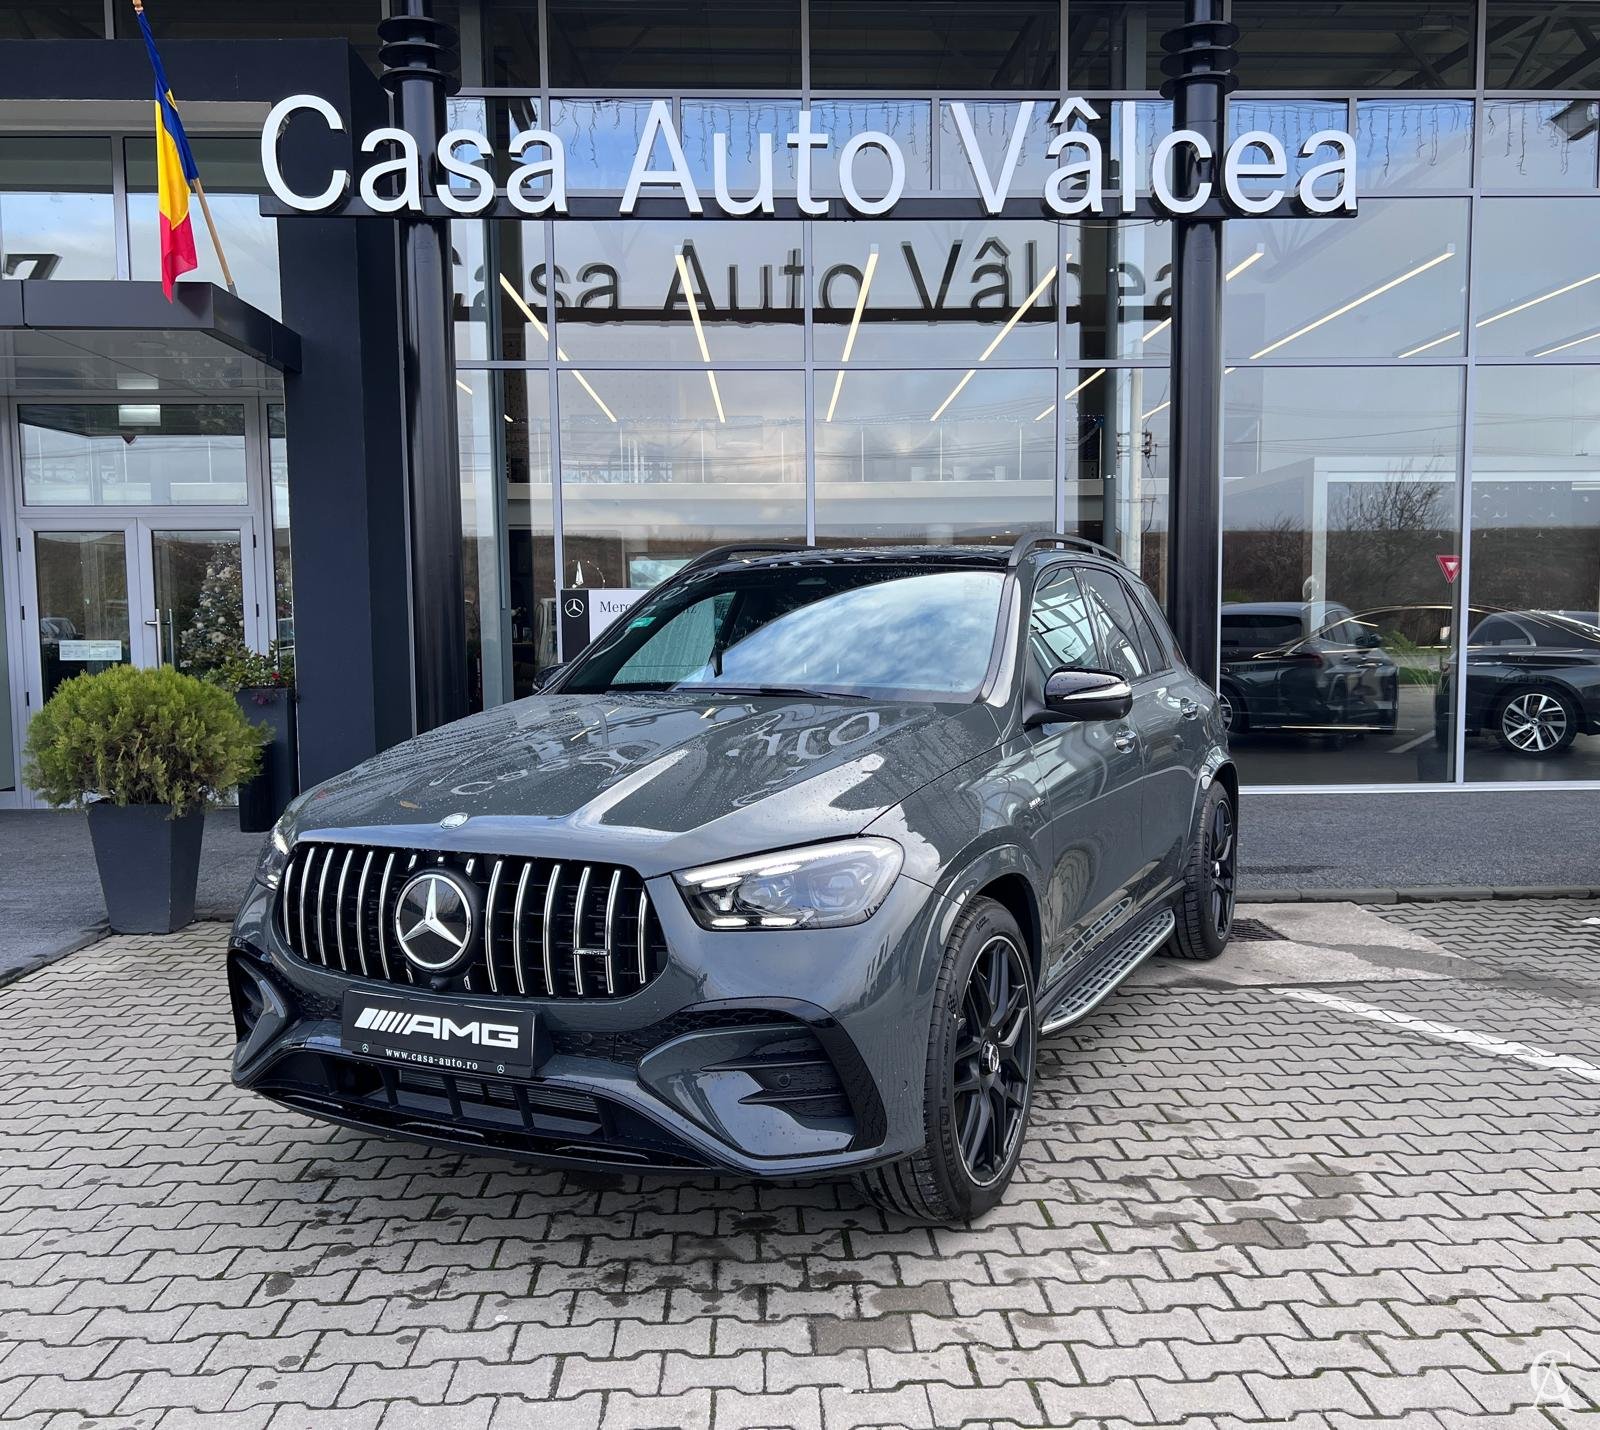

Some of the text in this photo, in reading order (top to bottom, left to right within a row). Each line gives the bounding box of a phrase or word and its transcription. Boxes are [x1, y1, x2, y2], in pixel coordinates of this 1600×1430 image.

[260, 94, 1358, 216] Casa Auto Vâlcea
[599, 600, 632, 613] Merc
[402, 1014, 519, 1049] AMG
[385, 1048, 479, 1071] www.casa-auto.ro
